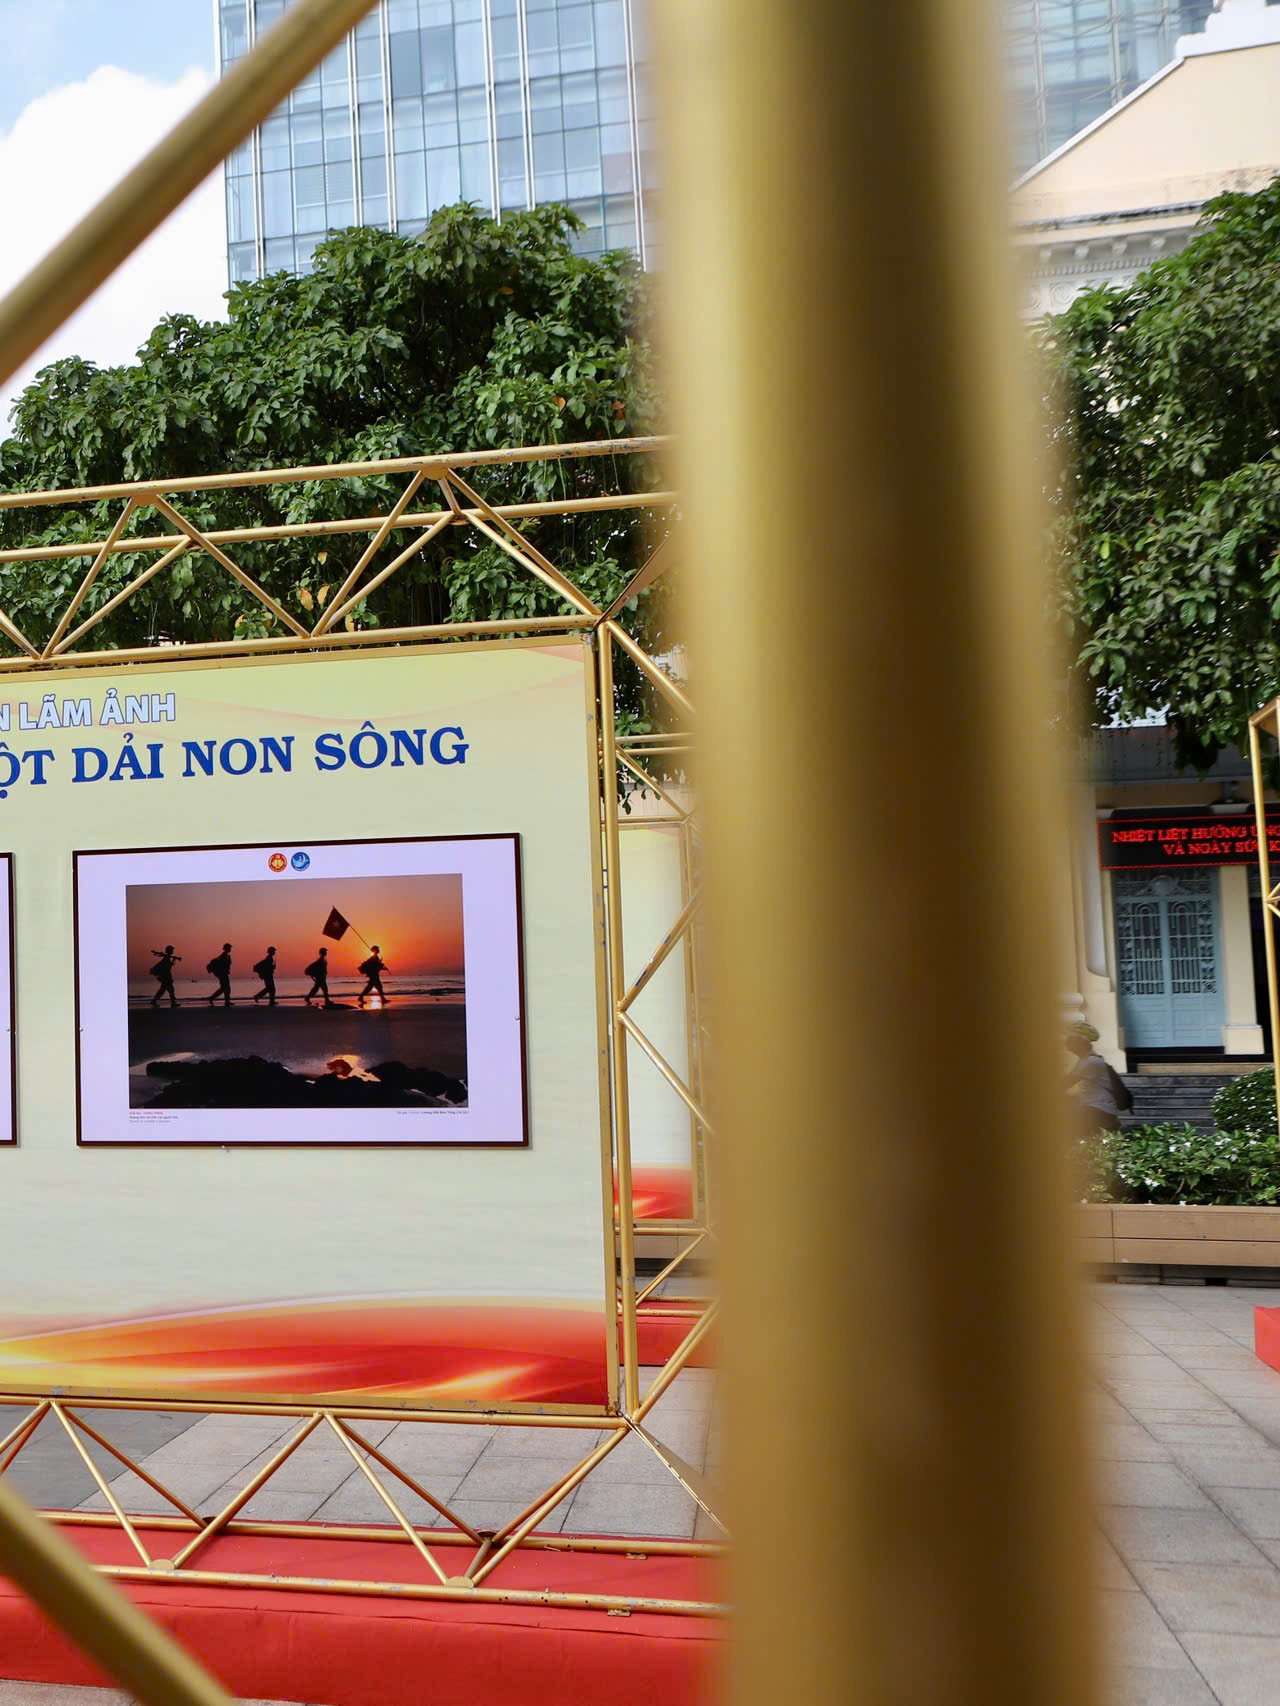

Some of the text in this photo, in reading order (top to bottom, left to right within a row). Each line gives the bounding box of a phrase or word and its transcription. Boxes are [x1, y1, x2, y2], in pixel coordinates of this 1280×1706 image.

[18, 694, 92, 730] LÃM
[99, 688, 176, 725] ẢNH
[71, 733, 166, 783] DẢI
[183, 735, 296, 777] NON
[314, 721, 471, 771] SÔNG
